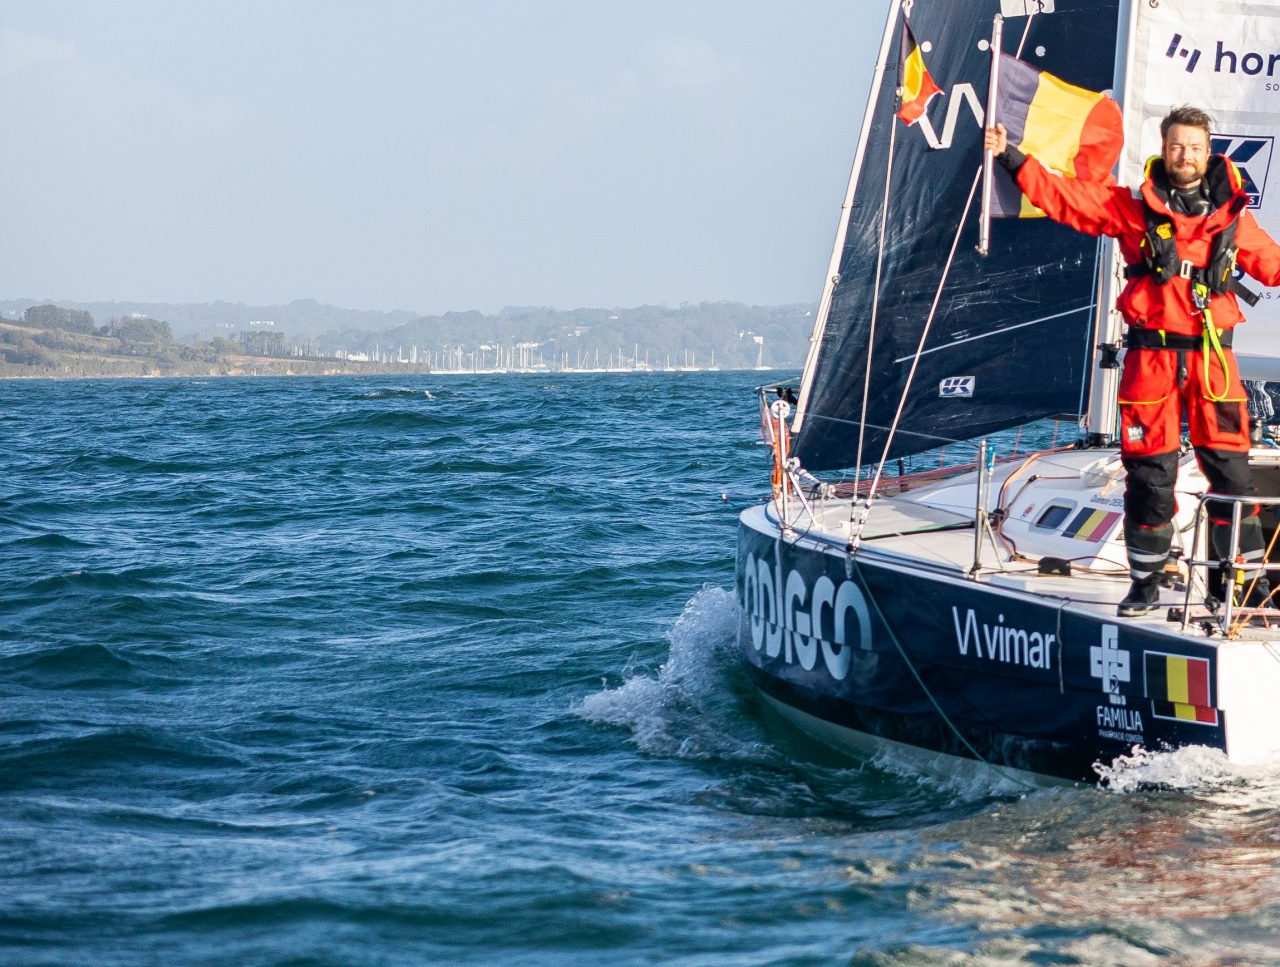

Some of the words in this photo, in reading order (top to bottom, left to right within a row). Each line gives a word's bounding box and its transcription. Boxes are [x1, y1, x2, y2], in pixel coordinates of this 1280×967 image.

[1258, 292, 1271, 300] AS
[983, 613, 1055, 670] vimar
[1096, 705, 1144, 732] FAMILIA
